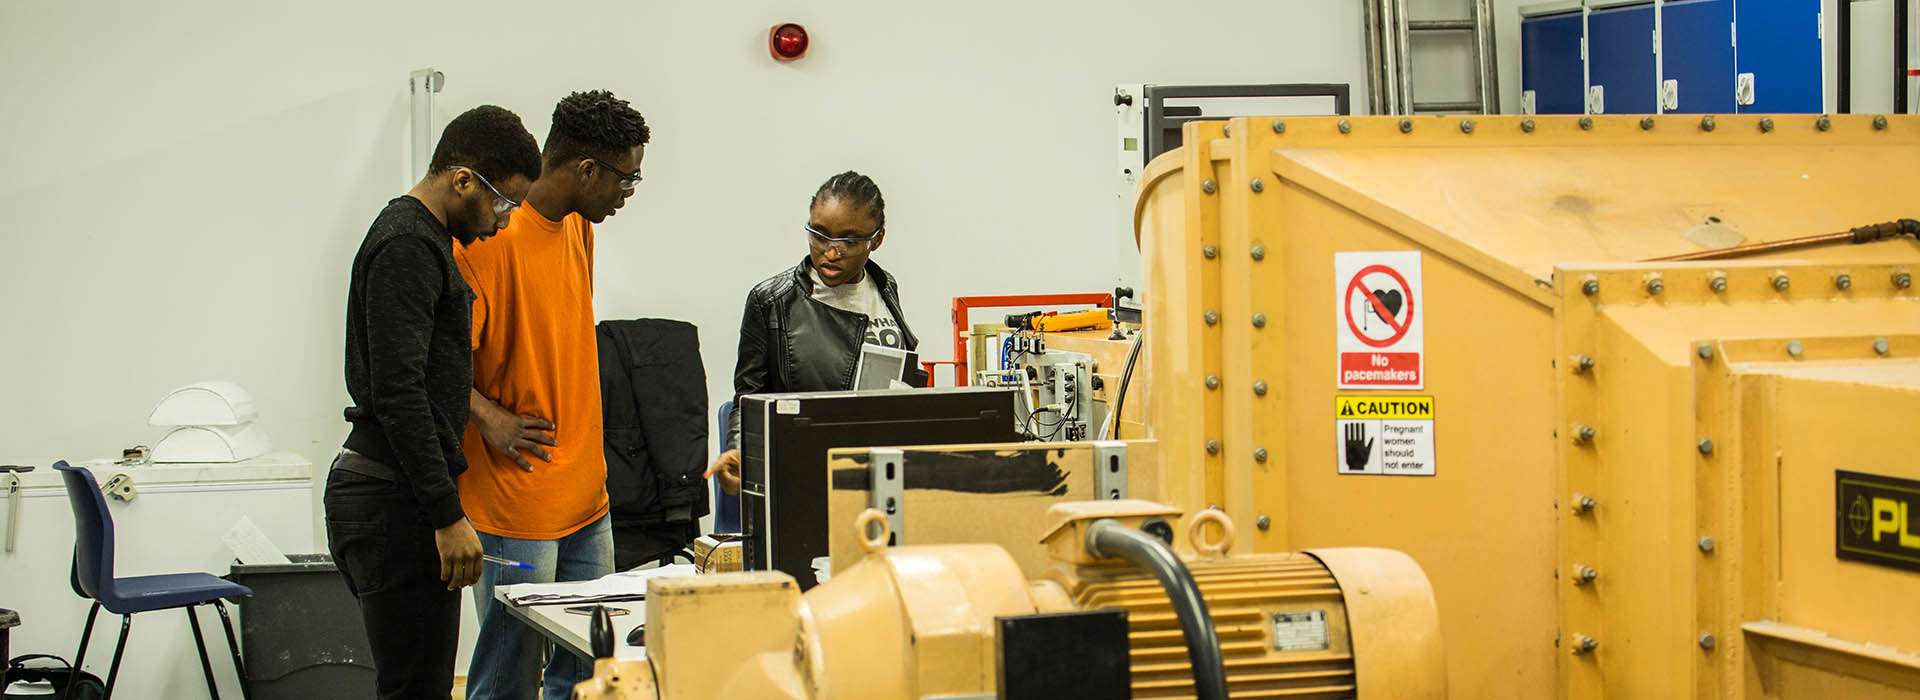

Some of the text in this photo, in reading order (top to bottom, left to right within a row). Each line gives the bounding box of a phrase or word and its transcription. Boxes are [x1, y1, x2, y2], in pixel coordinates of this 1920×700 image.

[864, 329, 905, 349] SO
[1371, 354, 1389, 366] No
[1344, 369, 1416, 383] pacemakers
[1357, 402, 1429, 415] CAUTION
[1384, 424, 1424, 435] Pregnant
[1384, 449, 1414, 457] should
[1385, 461, 1424, 469] not enter
